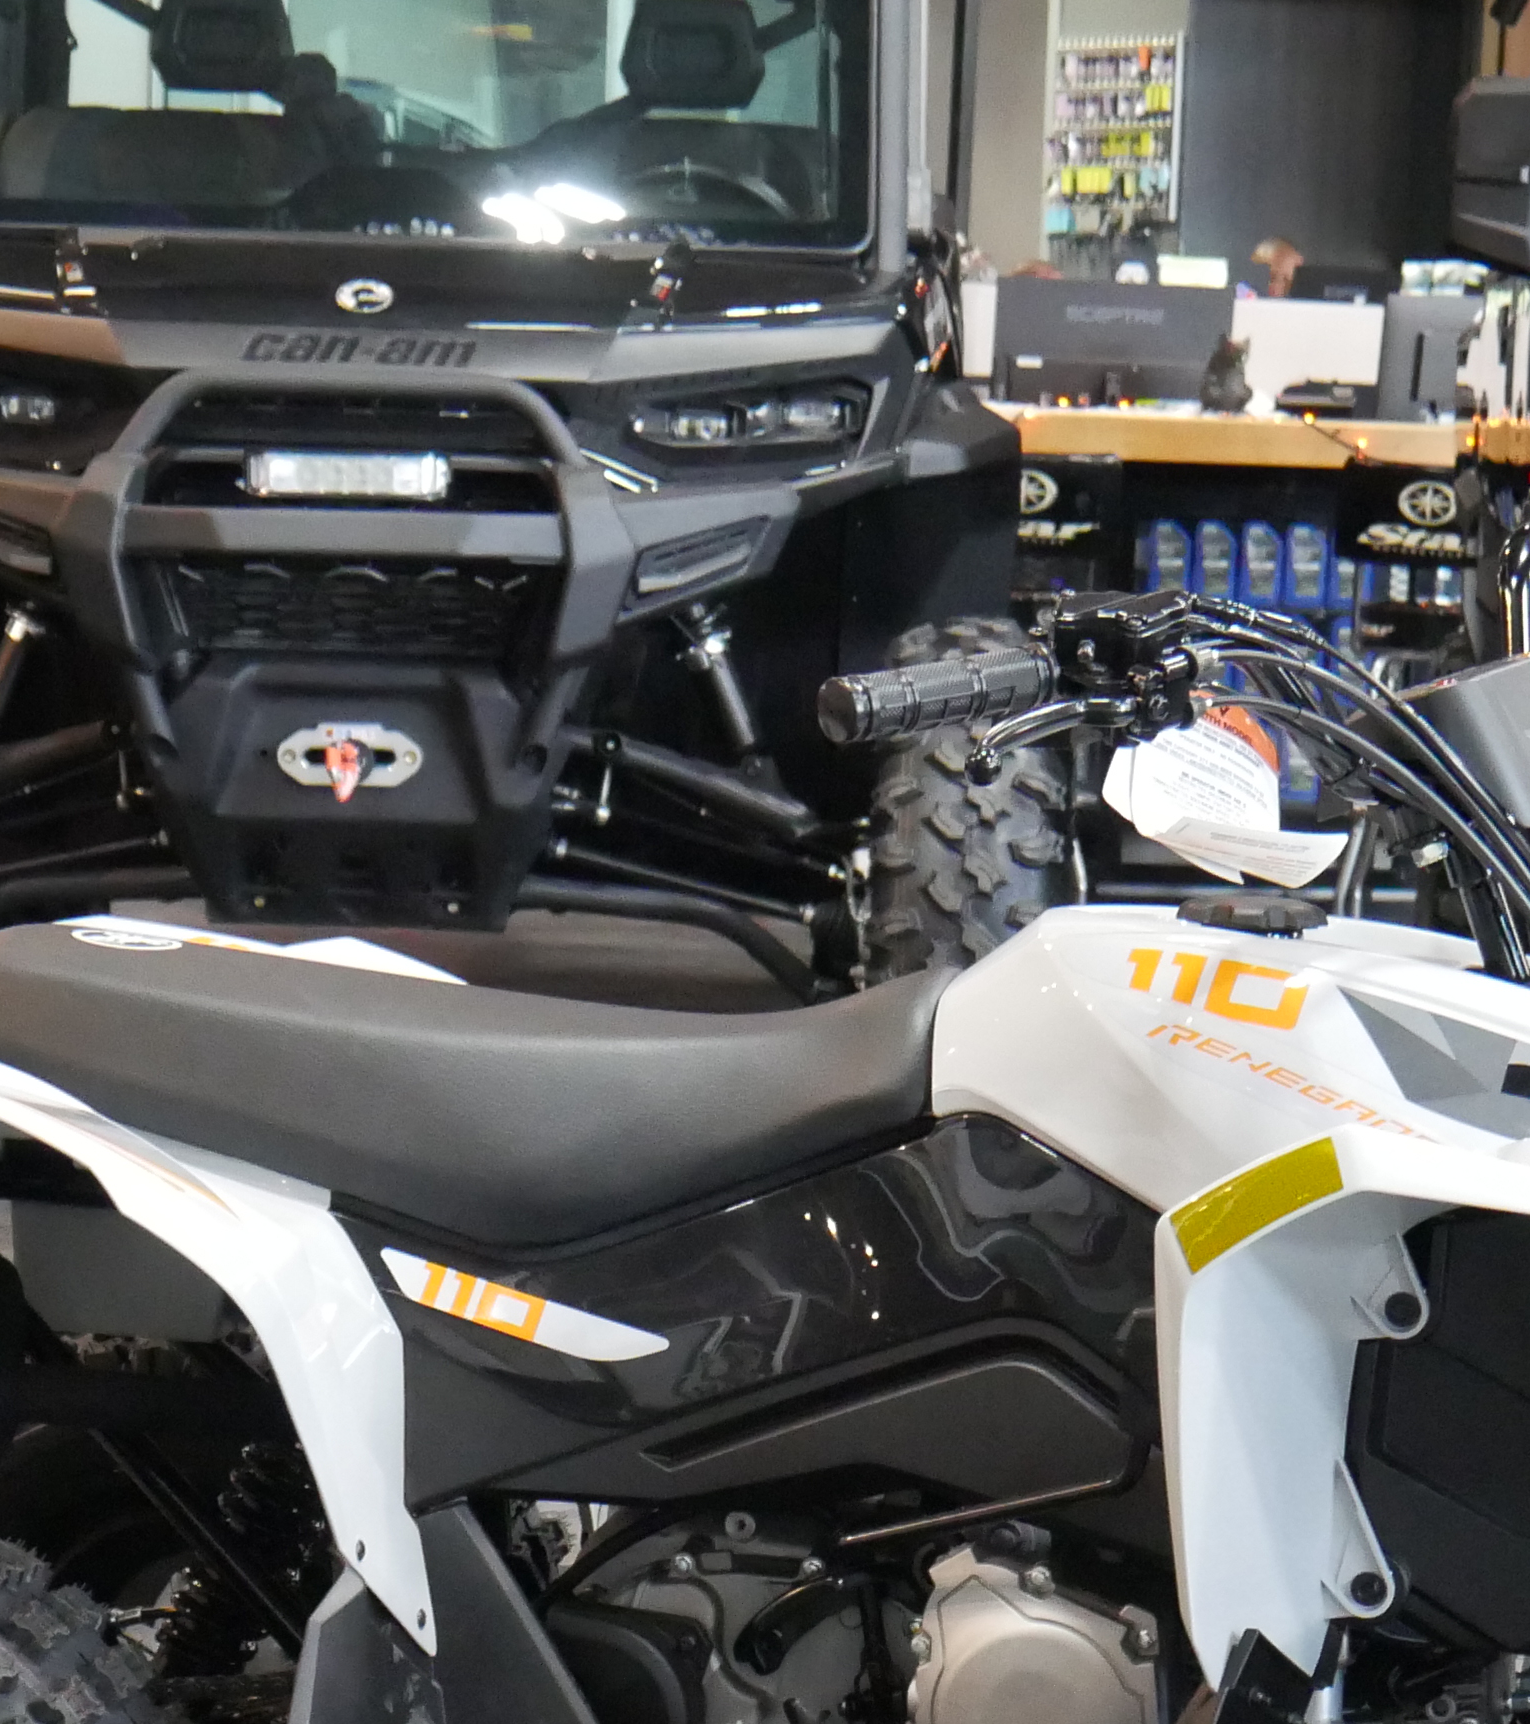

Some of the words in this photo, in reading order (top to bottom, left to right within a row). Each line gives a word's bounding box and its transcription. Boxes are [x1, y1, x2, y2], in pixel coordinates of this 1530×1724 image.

[240, 332, 477, 368] can-am
[1126, 947, 1310, 1031] 110
[419, 1260, 547, 1343] 110
